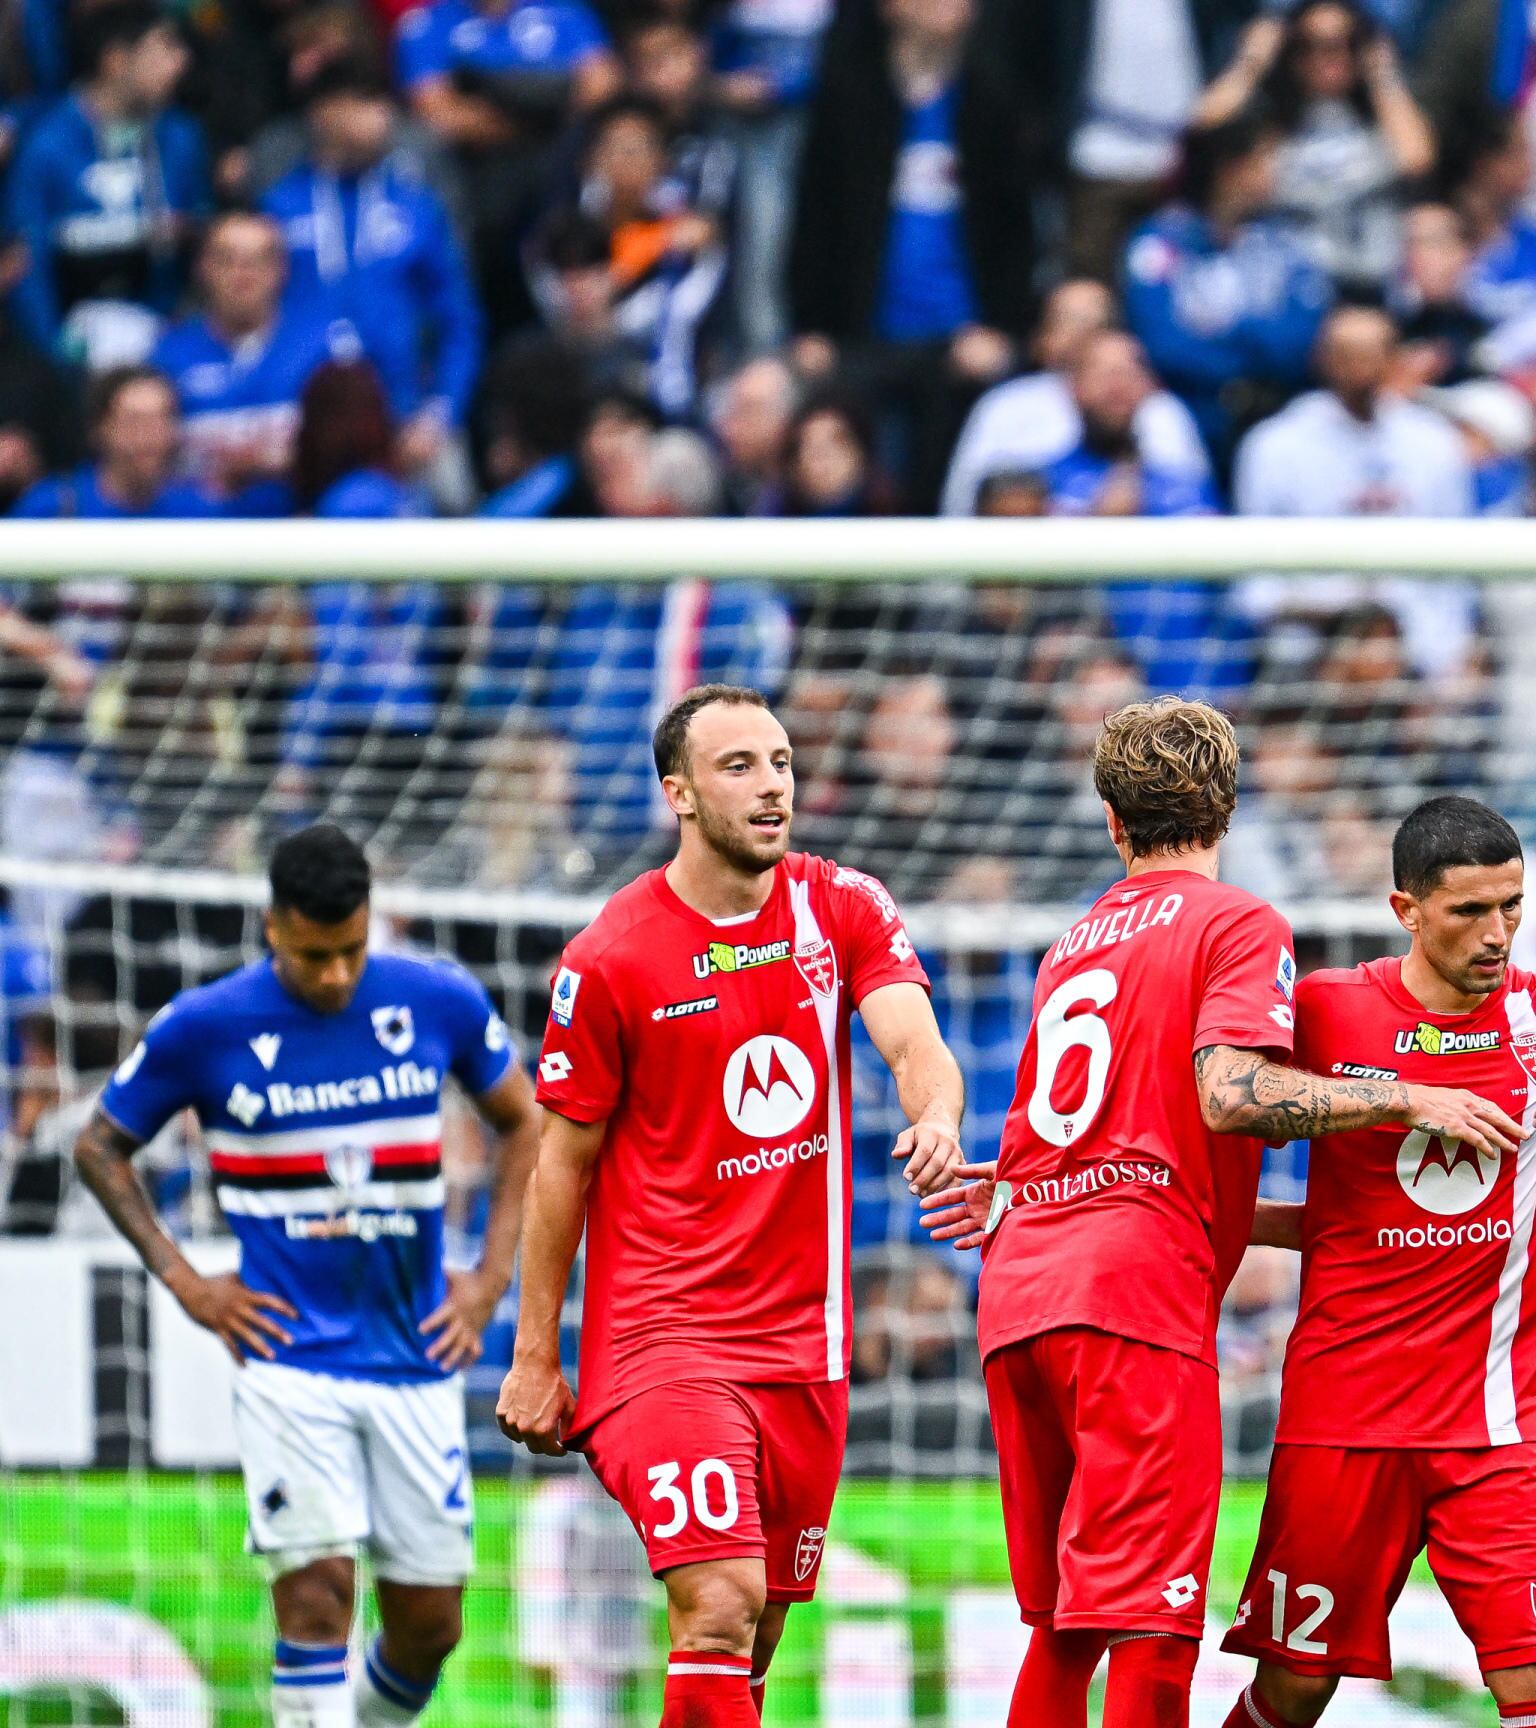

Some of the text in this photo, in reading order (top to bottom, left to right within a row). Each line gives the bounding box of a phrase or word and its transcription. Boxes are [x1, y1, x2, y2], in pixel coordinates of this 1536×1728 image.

[1050, 893, 1184, 968] ROVELLA
[666, 997, 718, 1018] LOTTO
[1028, 968, 1118, 1148] 6
[1342, 1065, 1399, 1081] LOTTO
[266, 1073, 383, 1118] Banca
[716, 1132, 830, 1181] motorola
[1377, 1217, 1513, 1248] motorola
[647, 1458, 739, 1539] 30
[1267, 1568, 1335, 1656] 12
